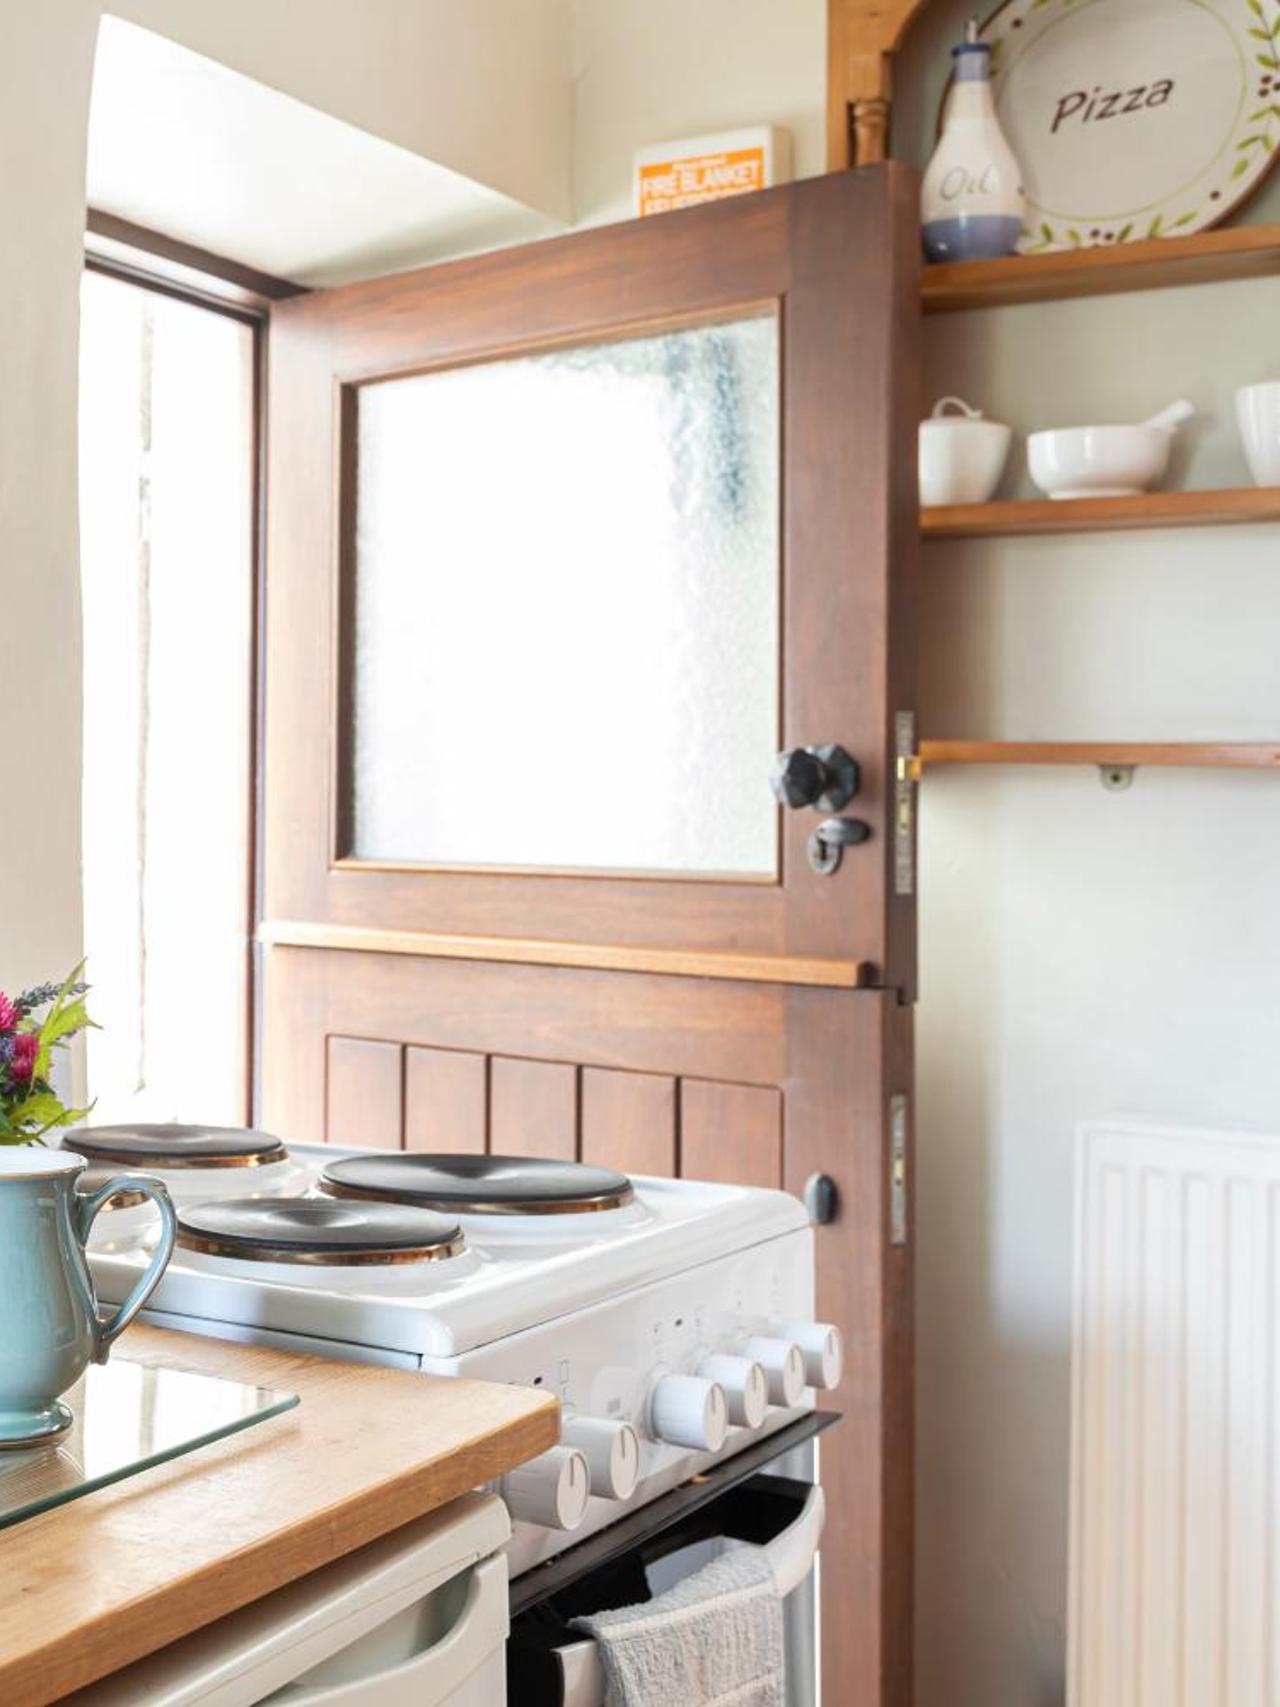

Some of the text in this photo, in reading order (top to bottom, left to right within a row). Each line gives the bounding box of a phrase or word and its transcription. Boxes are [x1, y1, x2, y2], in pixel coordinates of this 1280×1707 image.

[1050, 78, 1175, 134] Pizza
[642, 174, 676, 199] FIRE
[680, 158, 760, 193] BLANKET
[939, 163, 994, 201] Oil
